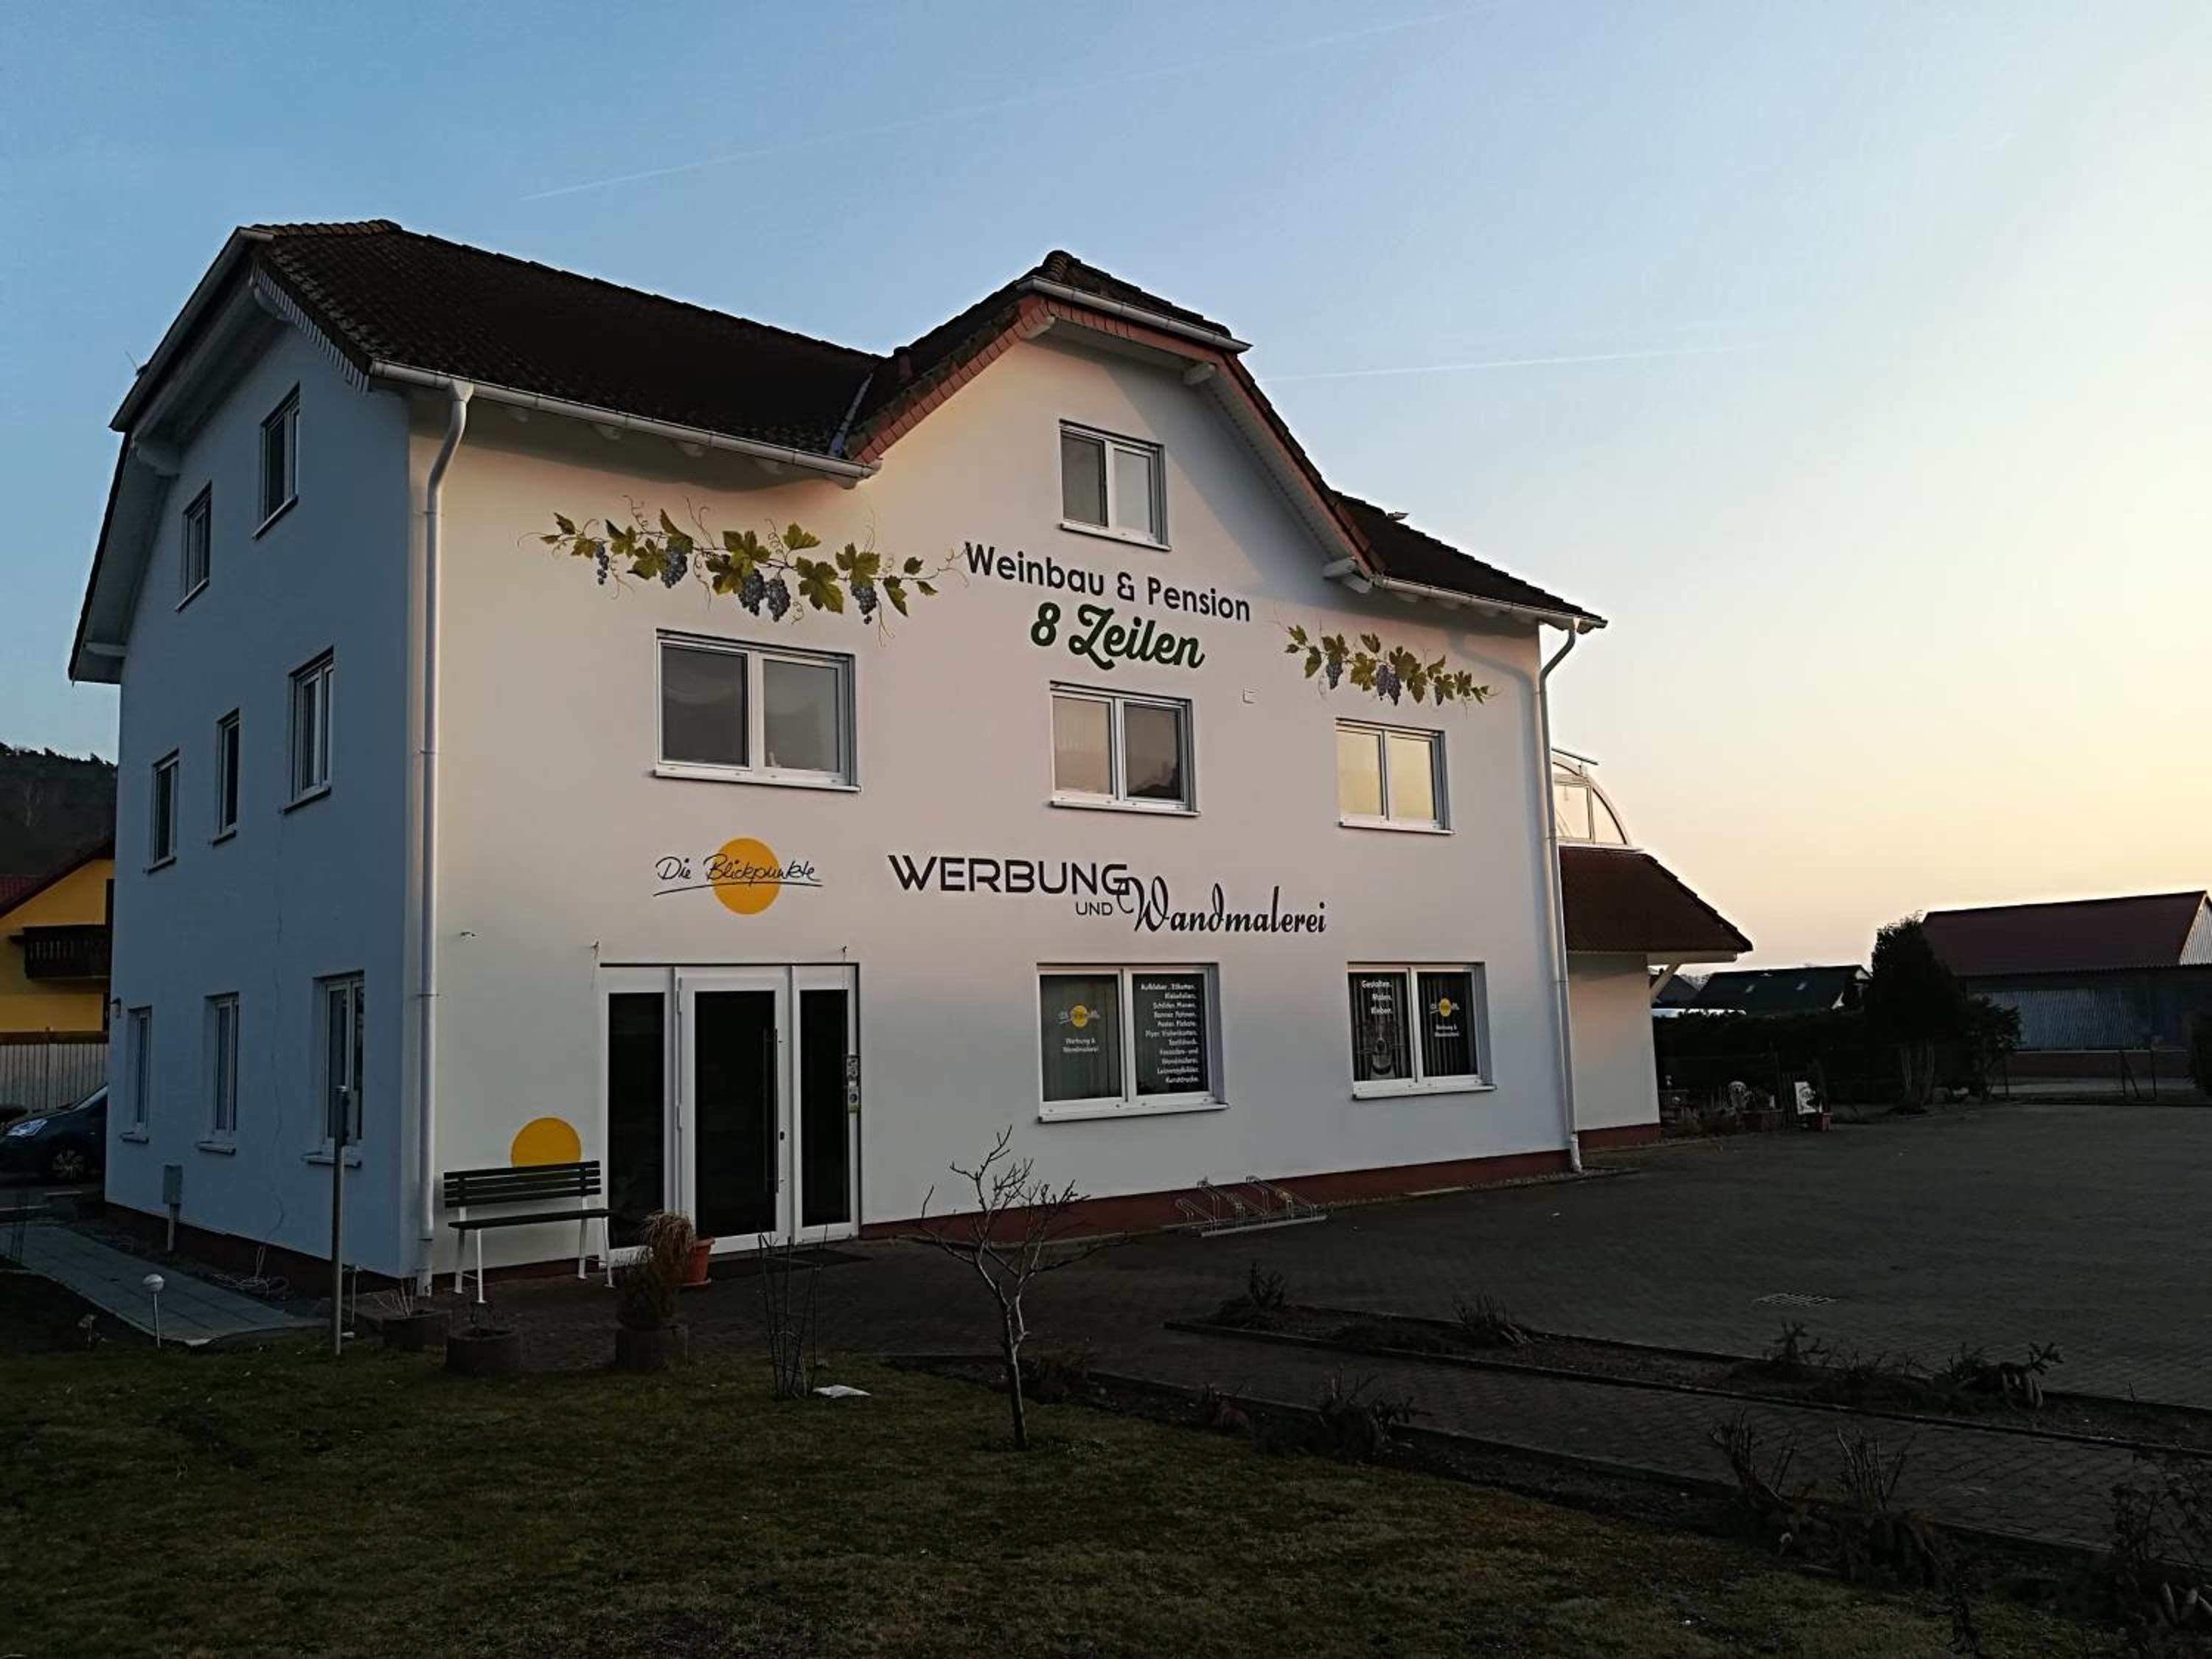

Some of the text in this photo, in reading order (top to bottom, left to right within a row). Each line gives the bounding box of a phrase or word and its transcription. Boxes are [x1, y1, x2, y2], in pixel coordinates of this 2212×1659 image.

[964, 542, 1251, 622] Weinbau & Pension
[1031, 602, 1206, 670] 8 Zeilen
[655, 856, 692, 880] Die
[888, 855, 1130, 896] WERBUNG
[1076, 901, 1113, 916] UND
[1117, 875, 1326, 933] Wandmalerei
